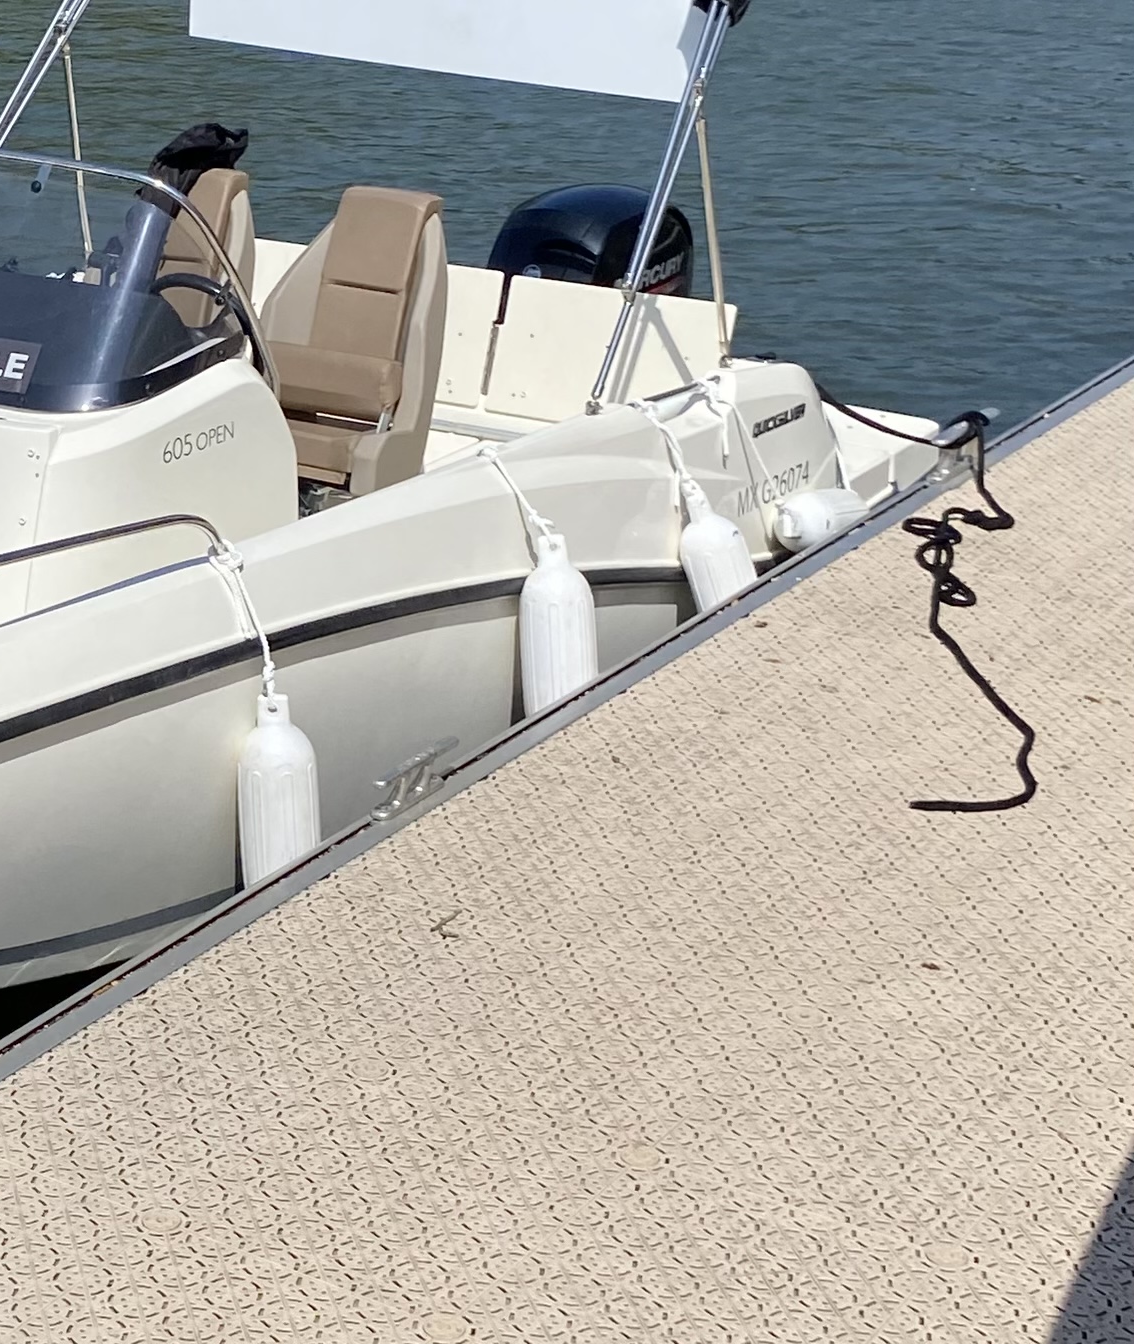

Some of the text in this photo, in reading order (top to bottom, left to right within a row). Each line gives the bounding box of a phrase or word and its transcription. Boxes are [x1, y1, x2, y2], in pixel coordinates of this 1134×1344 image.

[162, 420, 235, 464] 605 OPEN
[737, 460, 809, 518] MX G26074
